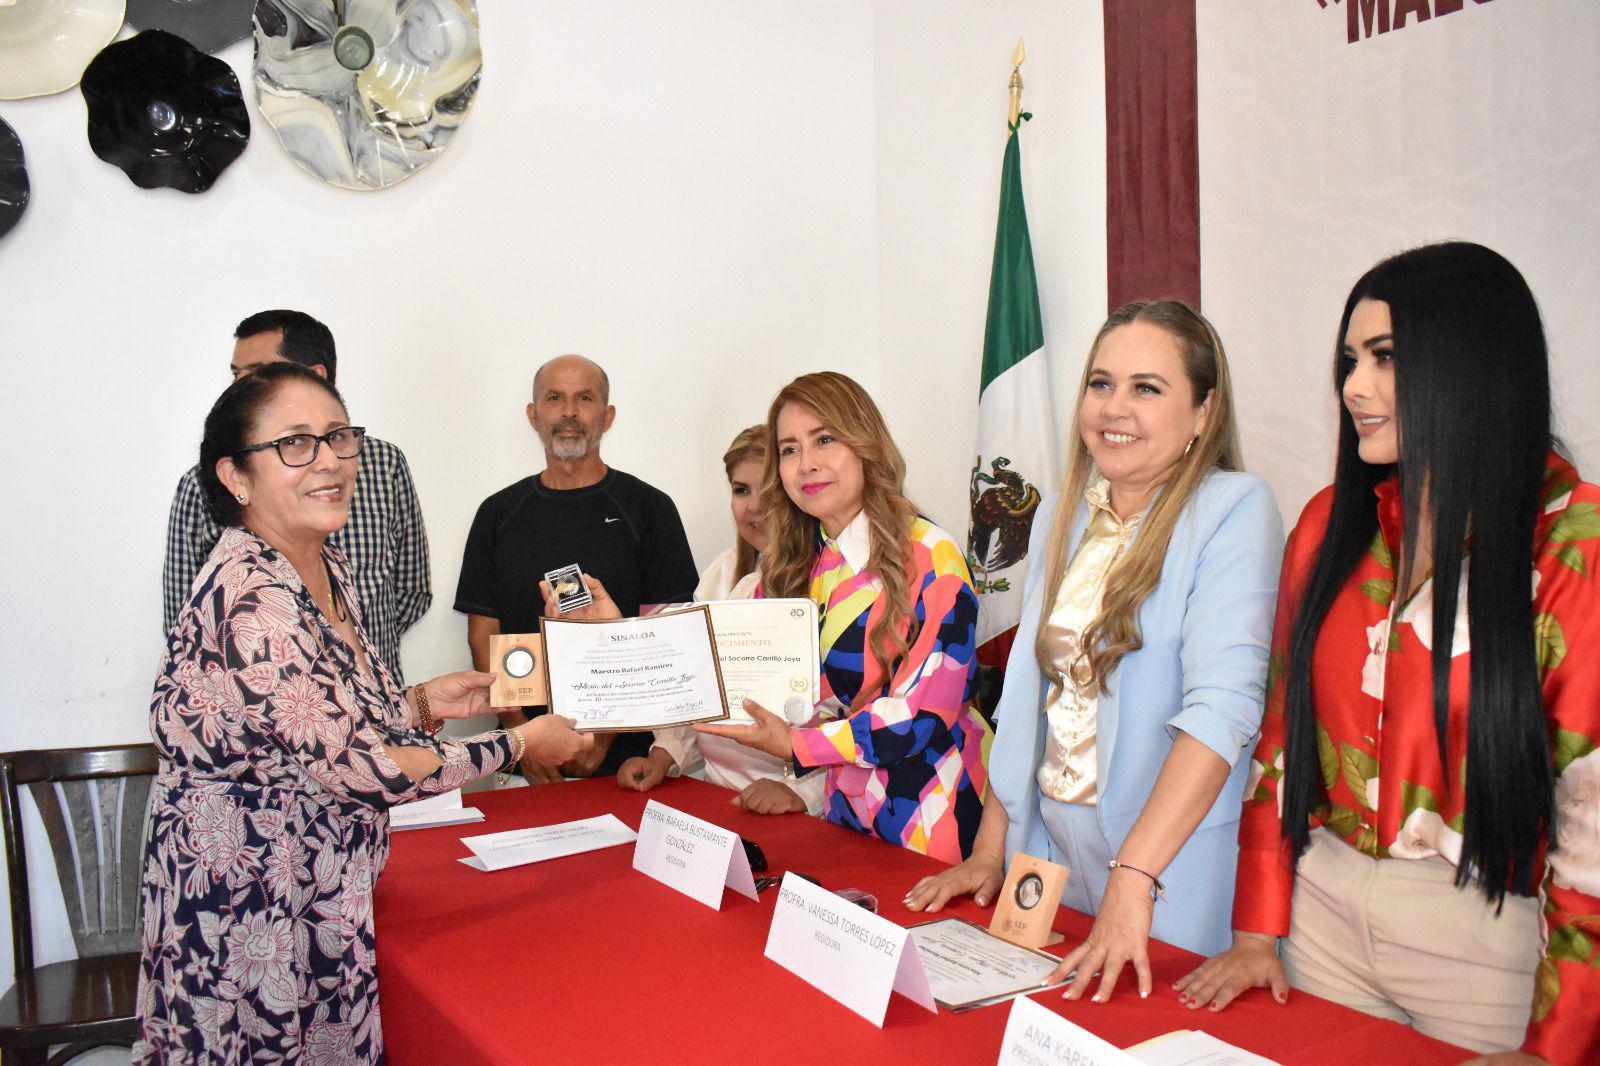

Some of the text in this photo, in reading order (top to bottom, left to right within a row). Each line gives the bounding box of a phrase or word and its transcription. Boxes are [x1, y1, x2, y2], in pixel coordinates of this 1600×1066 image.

[610, 631, 656, 642] SINALOA
[666, 815, 689, 832] RAFAELA
[690, 825, 728, 848] BUSTAMANTE
[808, 902, 839, 928] VANESSA
[840, 918, 870, 943] TORRES
[870, 933, 896, 957] LÓPEZ
[1013, 920, 1028, 930] SEP
[814, 930, 840, 952] REGIDORA
[1024, 1024, 1051, 1054] ANA
